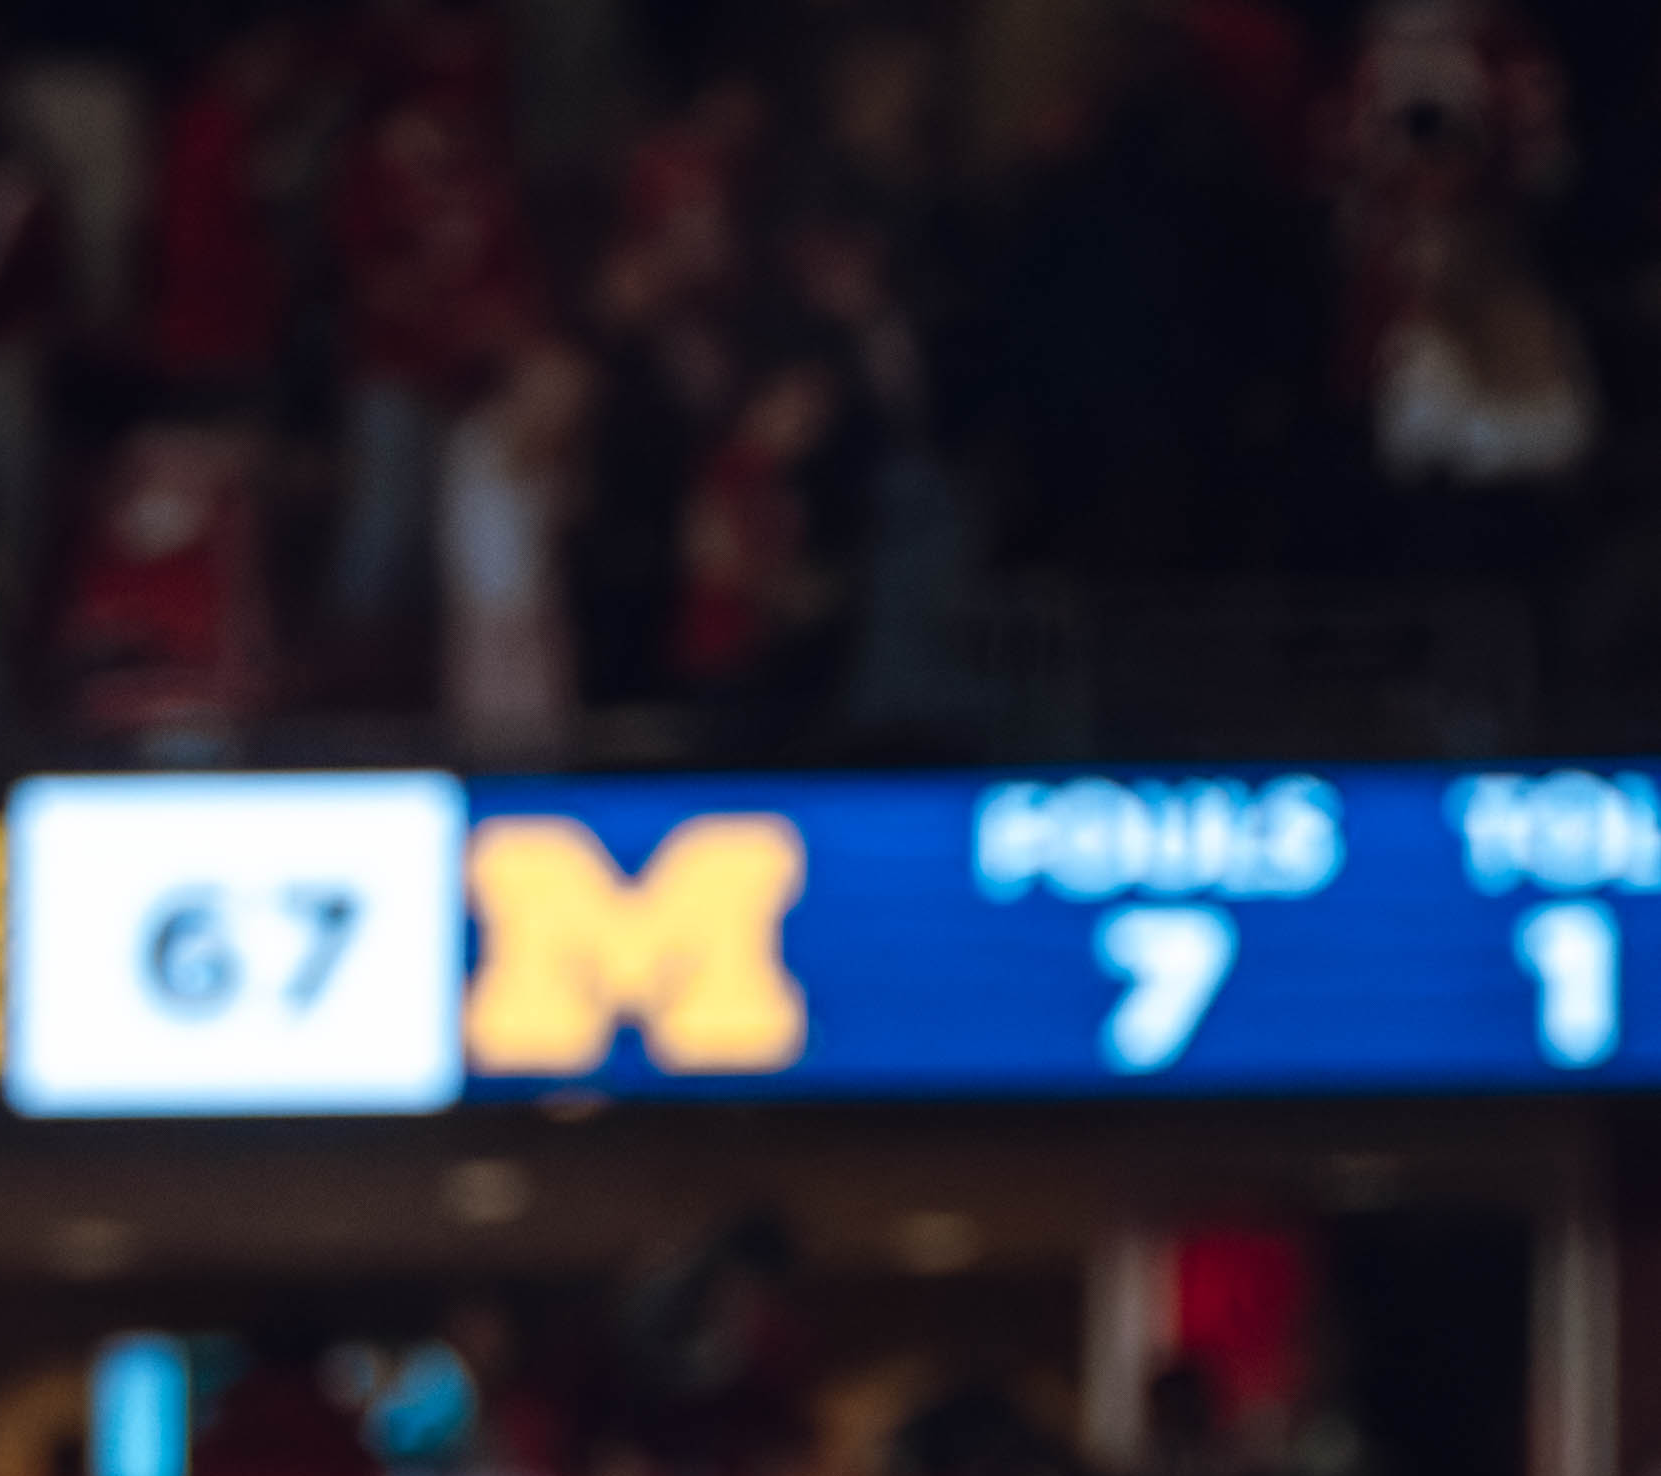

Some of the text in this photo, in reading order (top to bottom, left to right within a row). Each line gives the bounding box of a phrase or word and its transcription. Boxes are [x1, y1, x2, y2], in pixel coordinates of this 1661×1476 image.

[135, 880, 368, 1024] 67
[1094, 898, 1240, 1077] 7
[1516, 896, 1623, 1072] 1
